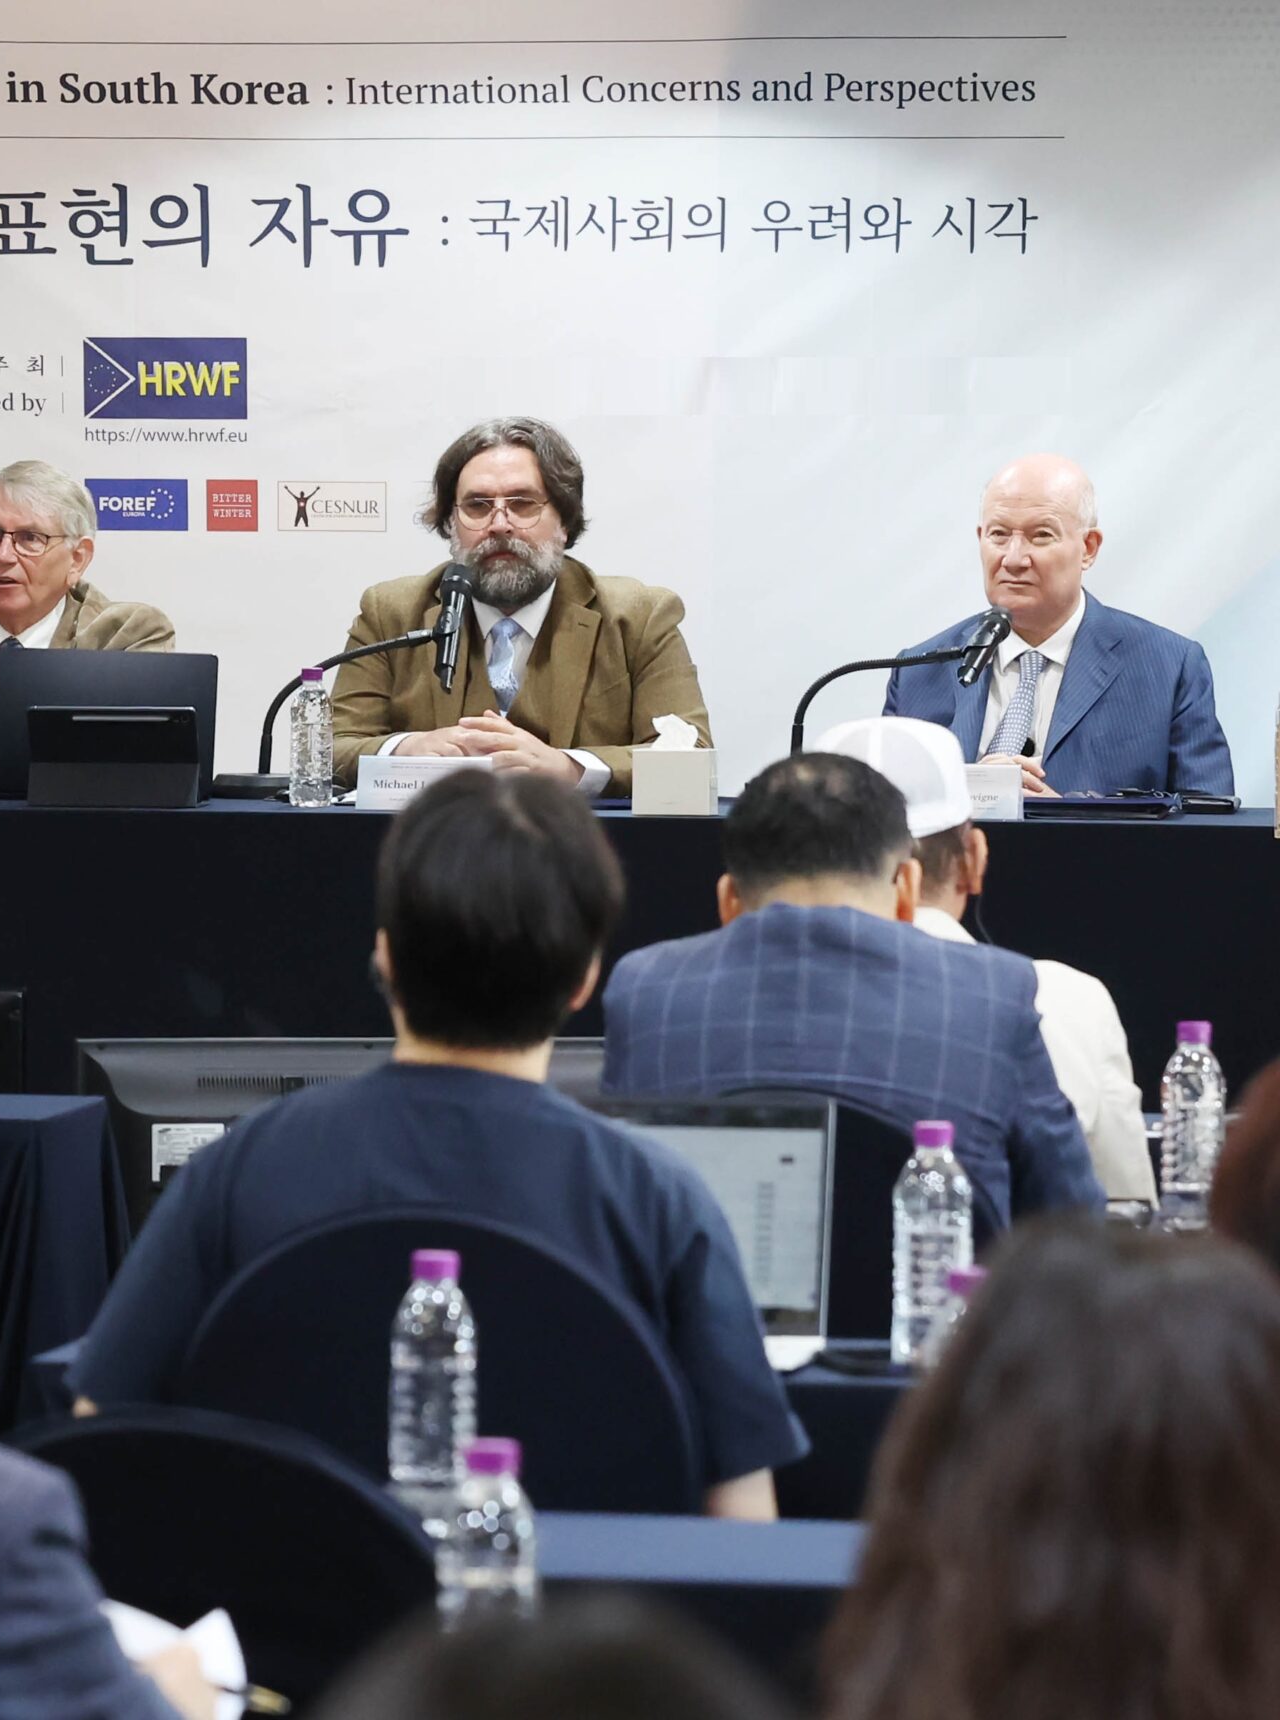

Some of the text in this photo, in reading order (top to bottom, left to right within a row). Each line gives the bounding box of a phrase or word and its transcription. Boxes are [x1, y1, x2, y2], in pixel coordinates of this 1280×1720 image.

[5, 70, 48, 103] in
[59, 71, 179, 105] South
[189, 73, 310, 106] Korea
[345, 74, 570, 105] International
[582, 75, 741, 104] Concerns
[751, 71, 814, 102] and
[824, 72, 1036, 110] Perspectives
[249, 183, 410, 269] 자유
[469, 195, 726, 254] 국제사회의
[751, 196, 913, 254] 우려와
[932, 196, 1039, 255] 시각
[137, 361, 240, 397] HRWF
[22, 392, 46, 417] by
[84, 426, 248, 445] https://www.hrwf.eu
[99, 496, 157, 512] FOREF
[212, 493, 253, 503] BITTER
[213, 508, 252, 518] WINTER
[311, 499, 379, 514] CESNUR
[373, 779, 418, 790] Michael
[970, 792, 999, 803] vigne
